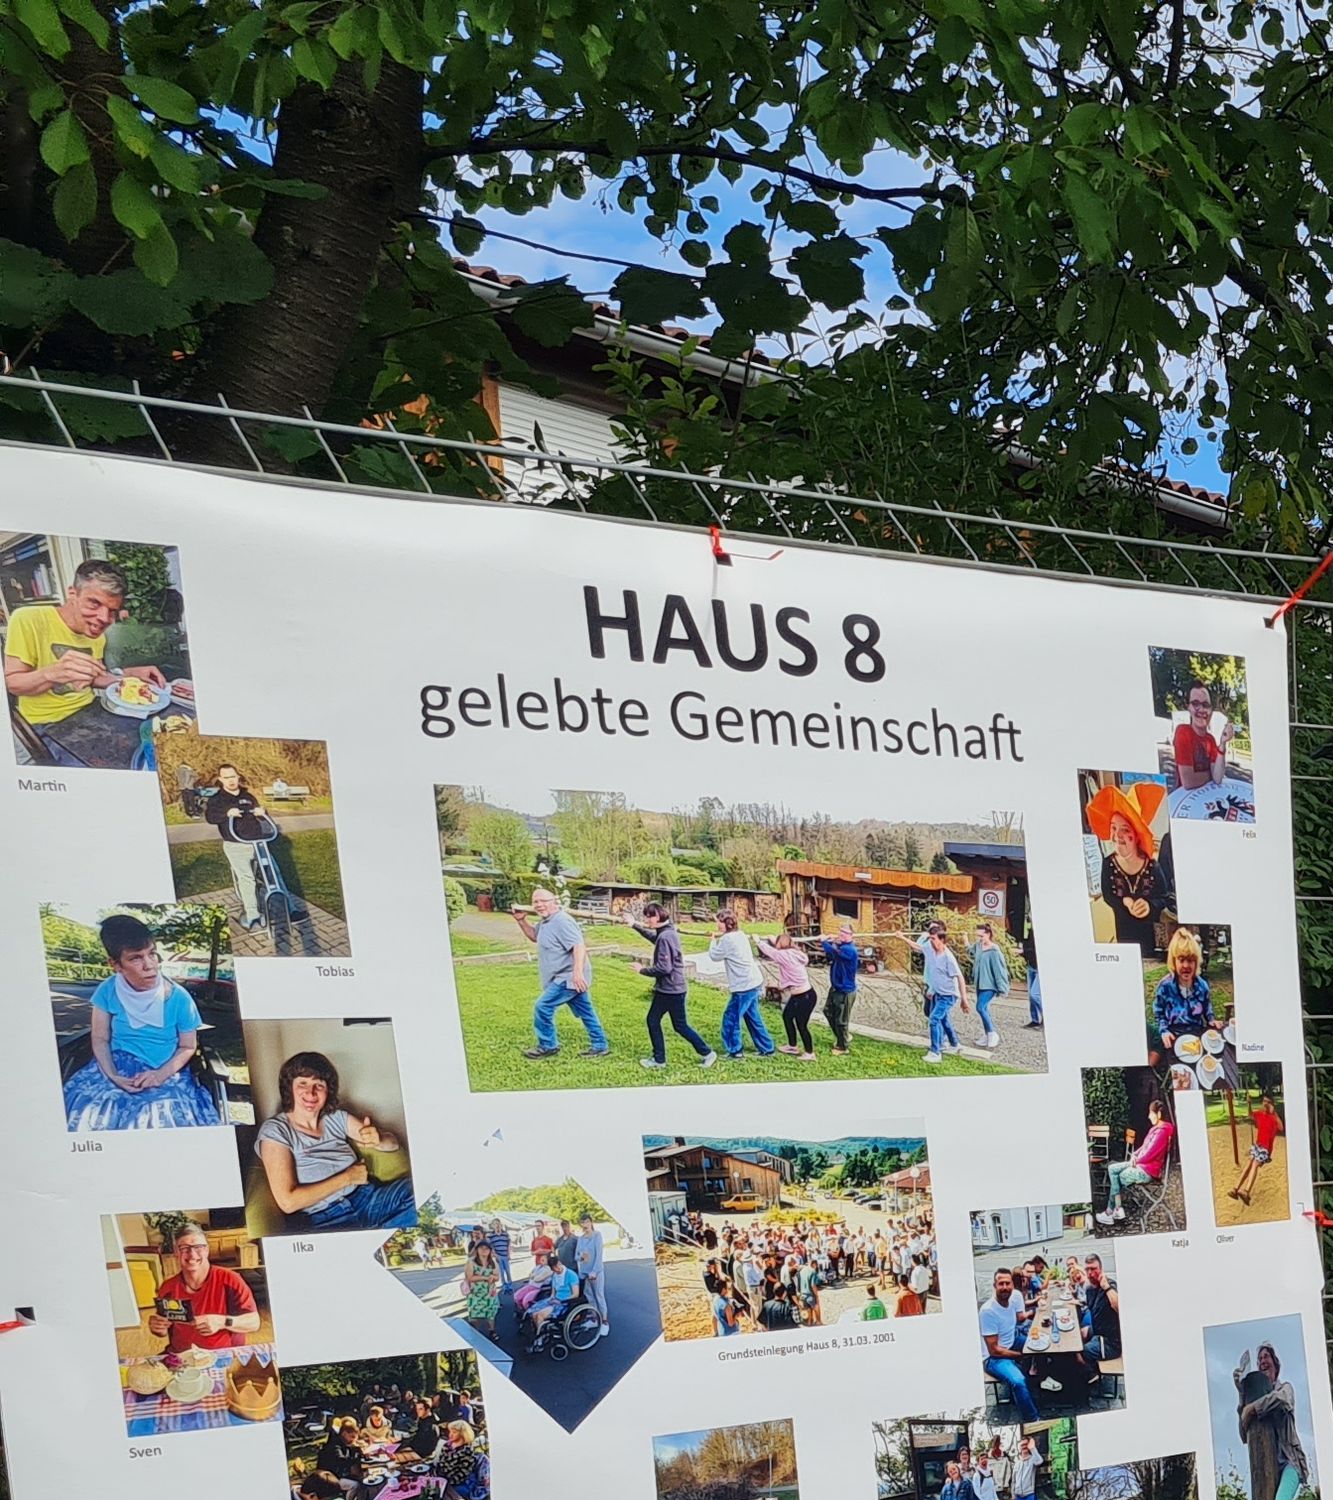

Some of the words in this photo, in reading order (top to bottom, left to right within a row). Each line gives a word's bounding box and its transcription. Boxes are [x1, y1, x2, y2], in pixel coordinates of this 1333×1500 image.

[583, 585, 818, 677] HAUS
[842, 614, 886, 683] 8
[420, 673, 649, 738] gelebte
[670, 690, 1024, 762] Gemeinschaft
[18, 779, 67, 792] Martin
[1242, 830, 1257, 839] Felix
[1095, 953, 1120, 962] Emma
[315, 965, 355, 977] Tobias
[1242, 1043, 1265, 1052] Nadine
[71, 1140, 103, 1153] Julia
[1171, 1238, 1189, 1248] Katja
[1216, 1235, 1234, 1243] Oliver
[292, 1242, 314, 1253] Ilka
[718, 1343, 804, 1362] Grundsteinlegung
[806, 1340, 830, 1351] Haus
[831, 1338, 841, 1350] 8,
[873, 1332, 896, 1344] 2001
[129, 1446, 162, 1459] Sven
